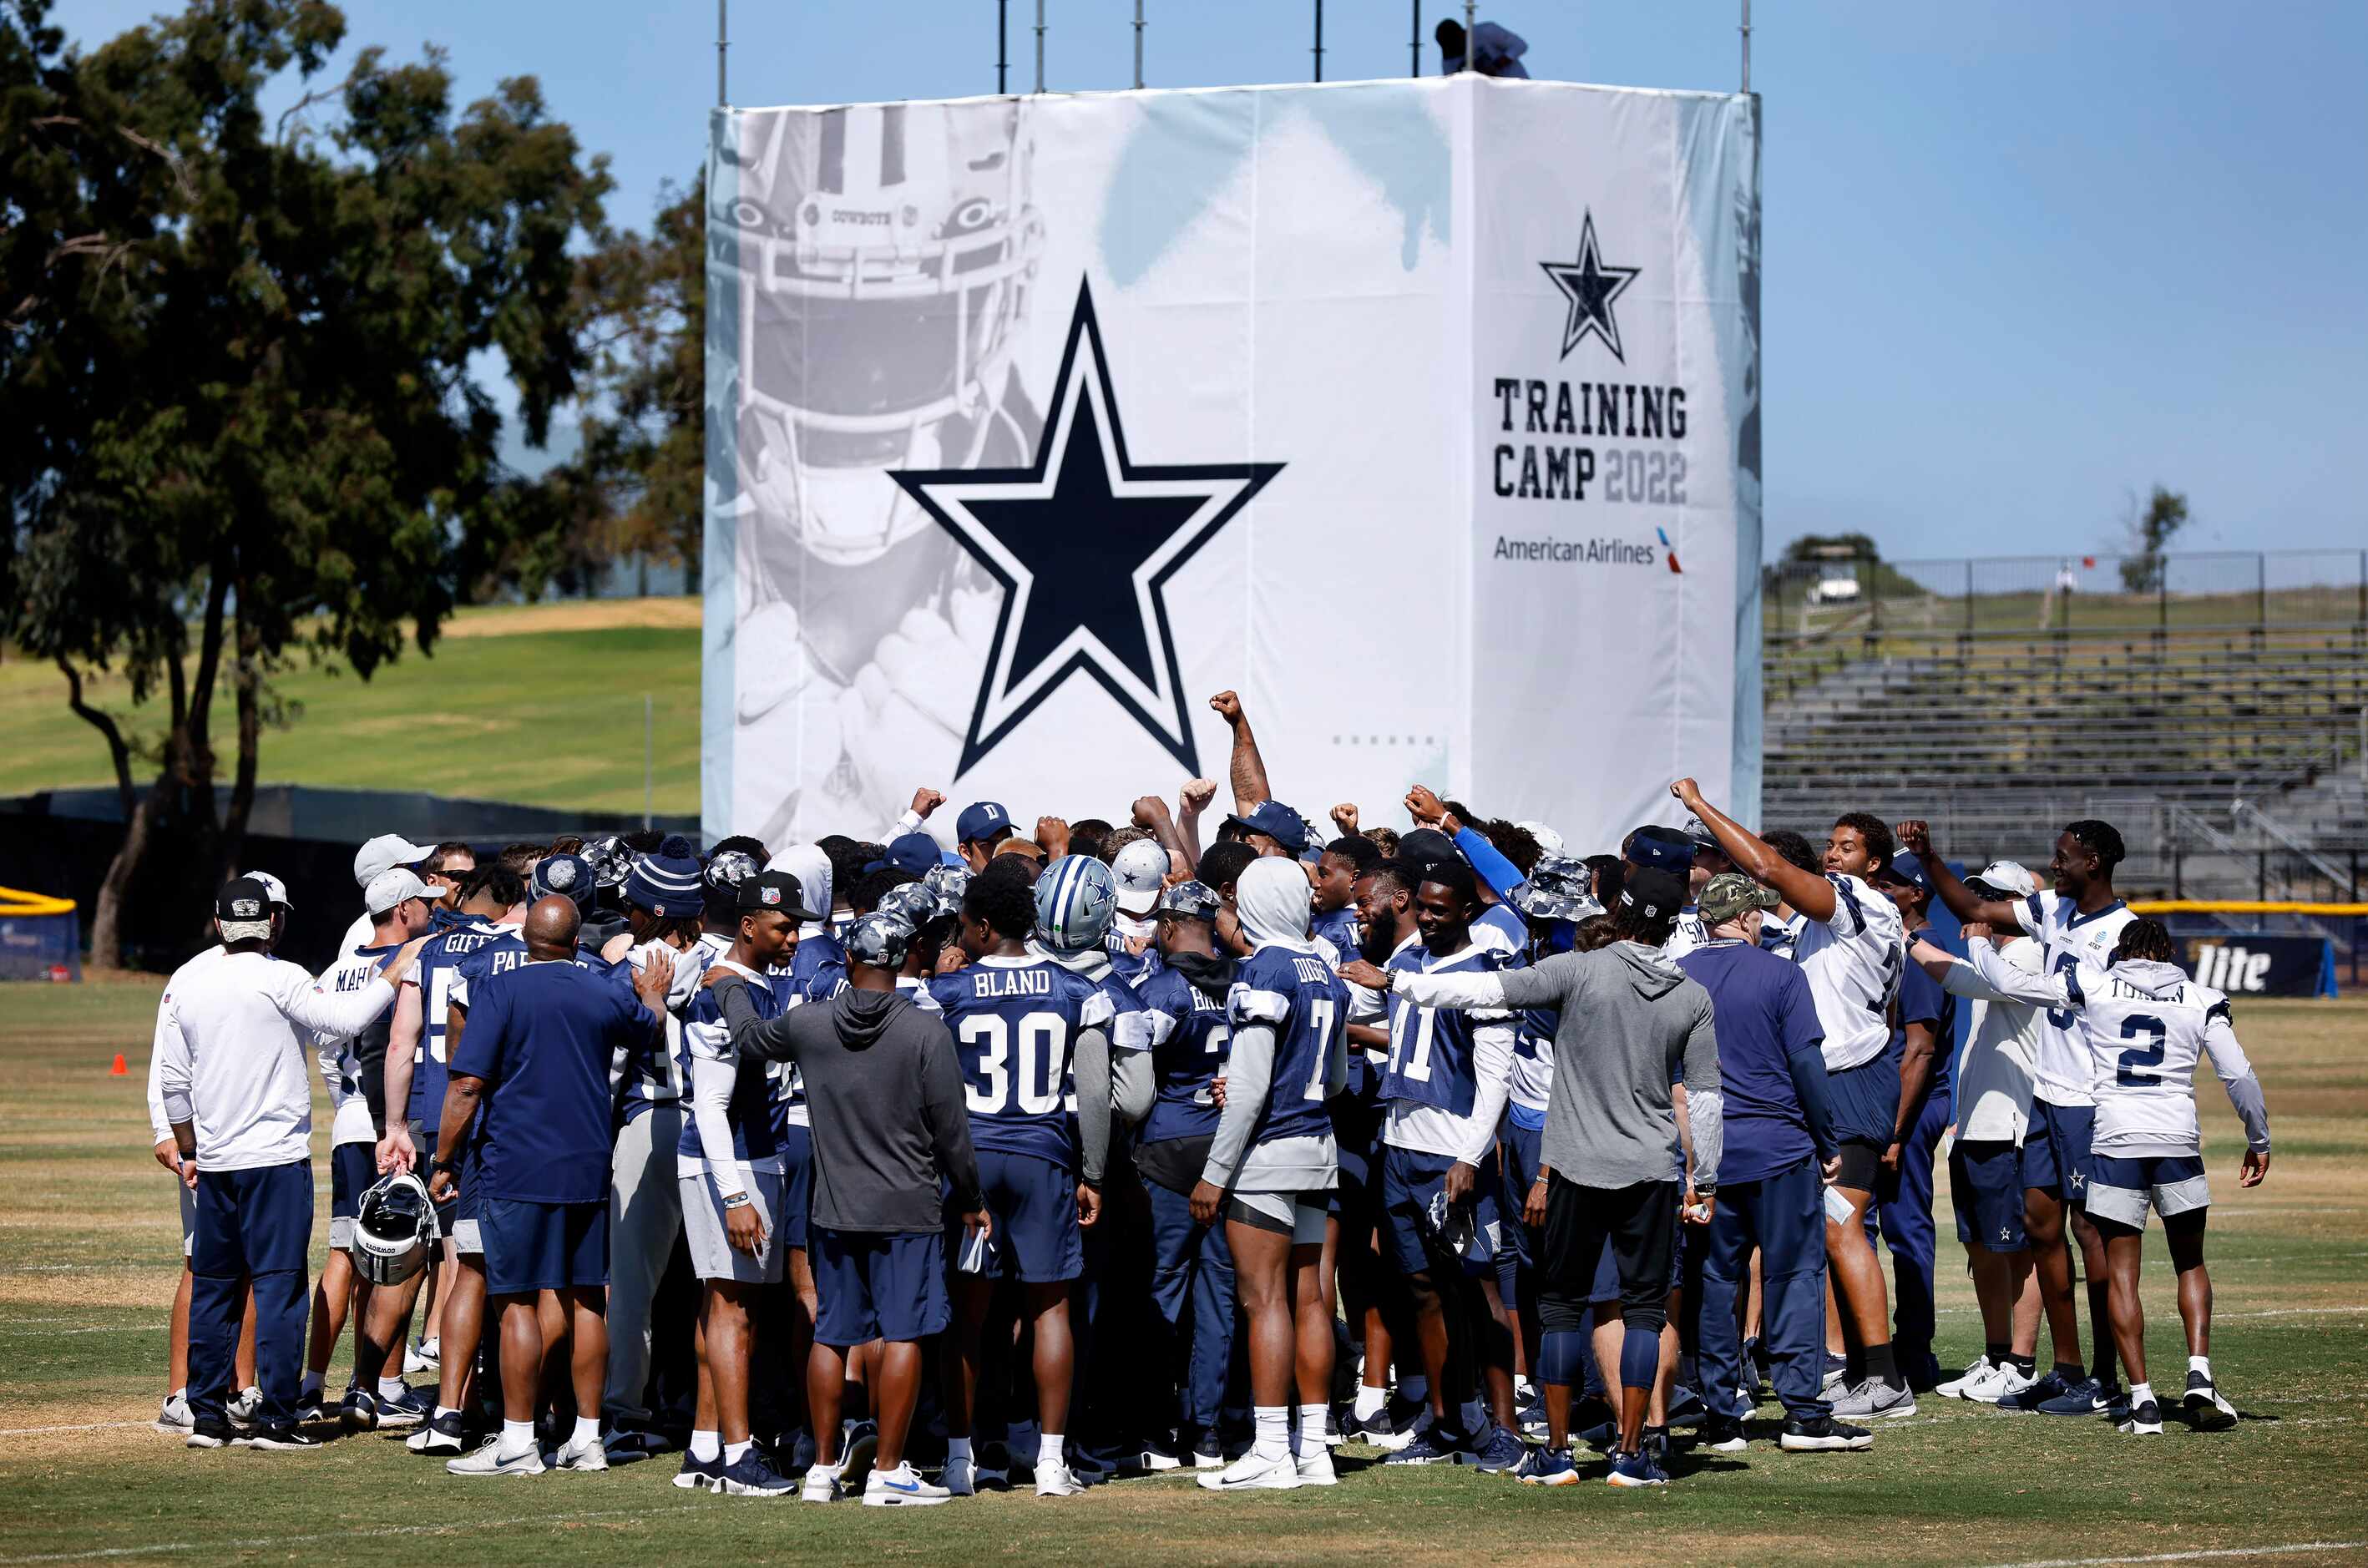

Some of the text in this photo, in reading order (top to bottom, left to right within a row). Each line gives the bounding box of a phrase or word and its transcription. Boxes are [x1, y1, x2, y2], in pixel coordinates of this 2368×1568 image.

[1494, 377, 1687, 439] TRAINING
[1494, 443, 1687, 504] CAMP 2022
[1494, 535, 1655, 564] American Airlines
[982, 804, 999, 820] D
[444, 933, 500, 953] GIFF
[2088, 941, 2102, 951] AT&T
[336, 967, 368, 992] MAH
[1291, 958, 1329, 985] DIGGS
[2195, 943, 2272, 991] lite
[974, 969, 1050, 998] BLAND
[959, 1011, 1067, 1115] 30
[1303, 999, 1334, 1101] 7
[2117, 1014, 2166, 1087] 2
